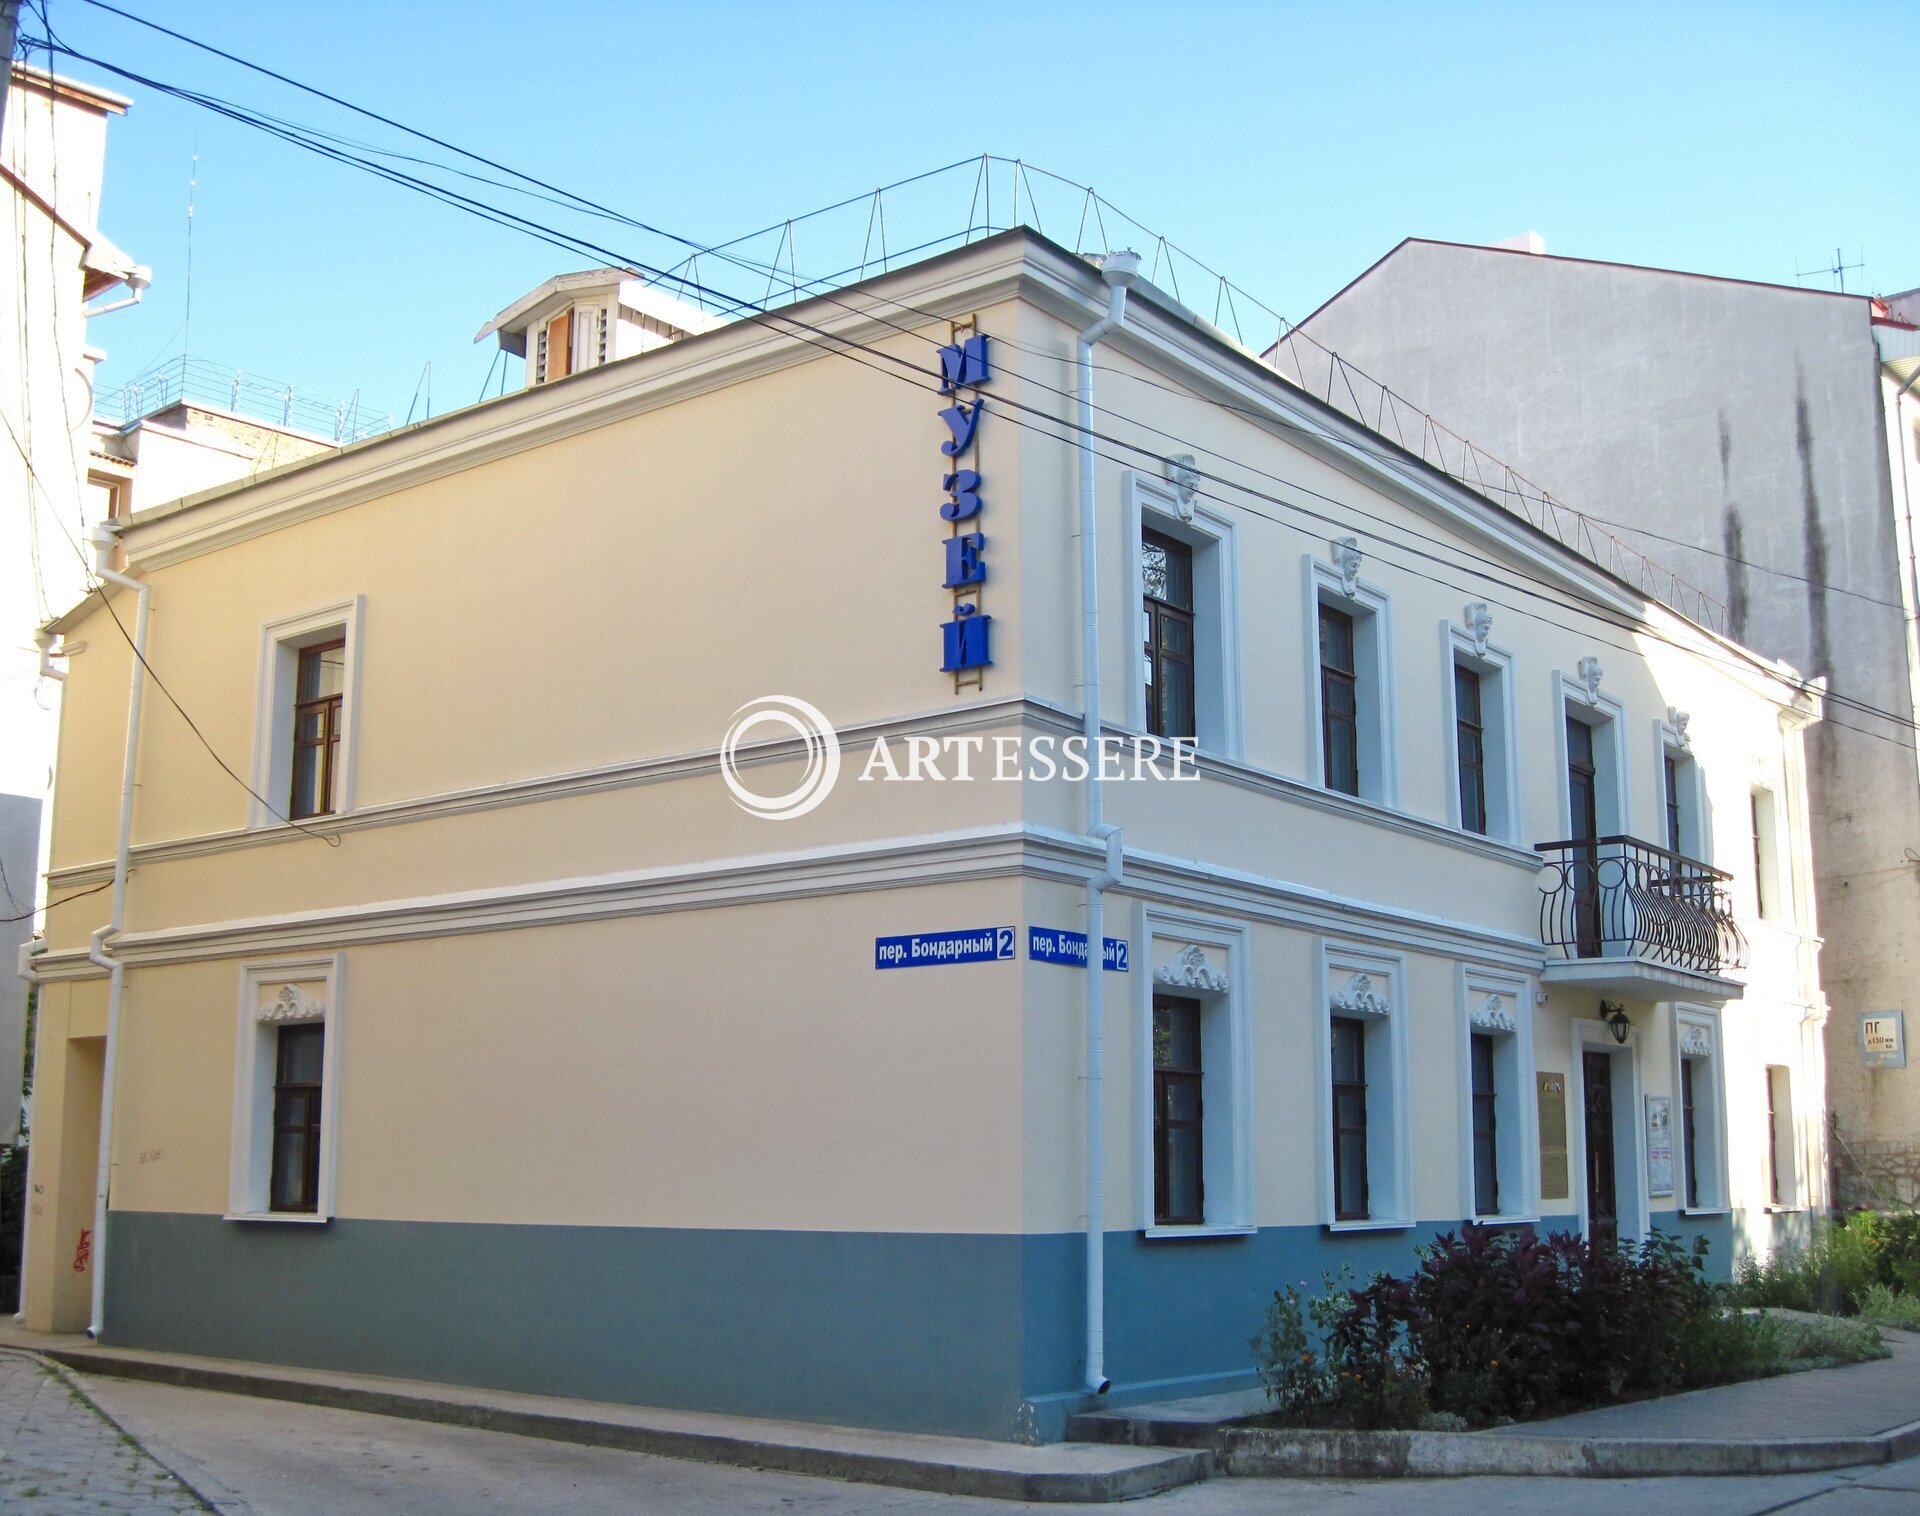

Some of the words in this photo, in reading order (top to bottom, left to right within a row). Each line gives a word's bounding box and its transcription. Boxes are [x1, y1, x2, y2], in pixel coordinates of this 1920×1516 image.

[936, 334, 993, 673] МУЗЕЙ
[879, 943, 907, 964] пер.
[911, 931, 993, 959] Бондарный
[998, 929, 1014, 957] 2
[1032, 935, 1056, 957] пер.
[1058, 934, 1115, 962] Бондаый
[1117, 943, 1128, 968] 2
[1865, 1022, 1880, 1034] ПГ
